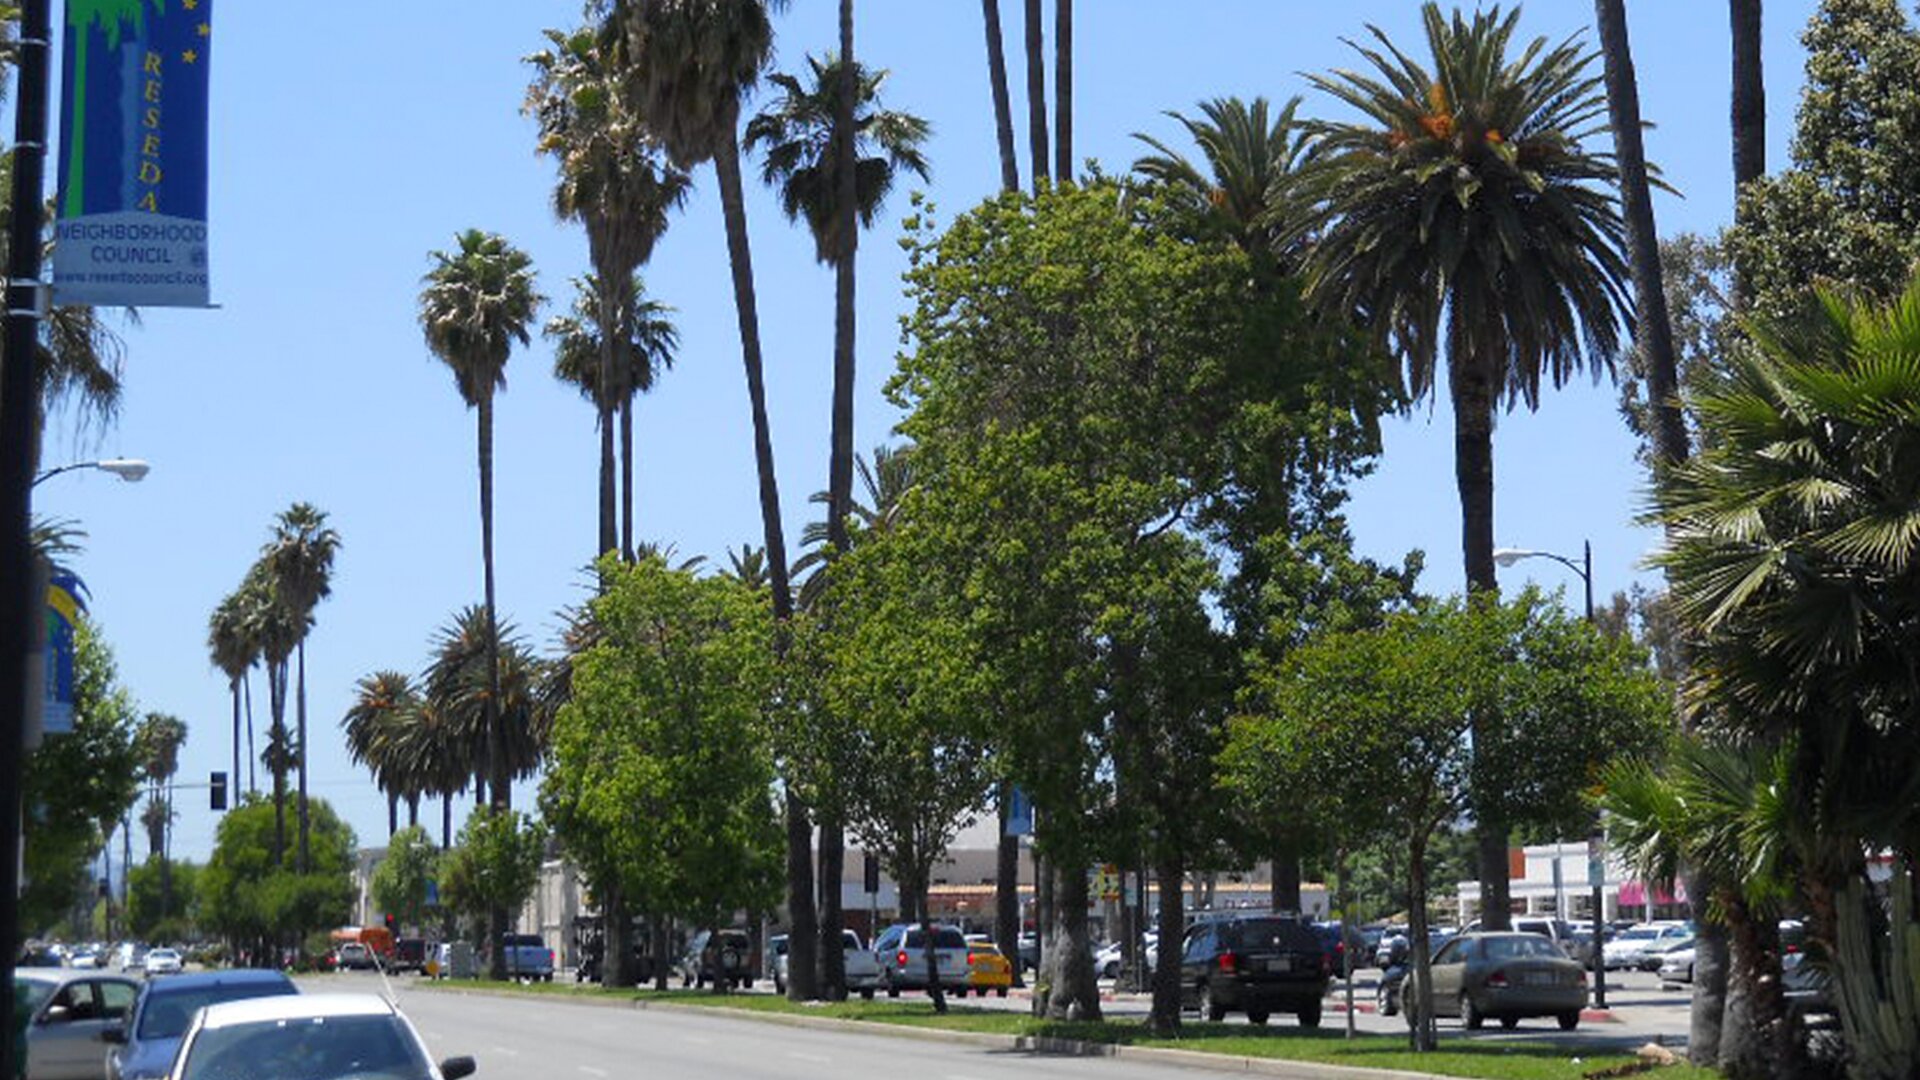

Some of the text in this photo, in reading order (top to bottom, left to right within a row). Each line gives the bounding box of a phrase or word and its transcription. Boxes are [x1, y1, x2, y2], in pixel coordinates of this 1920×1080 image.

[138, 51, 162, 213] RESEDA
[56, 223, 207, 242] NEIGHBORHOOD
[91, 246, 172, 264] COUNCIL
